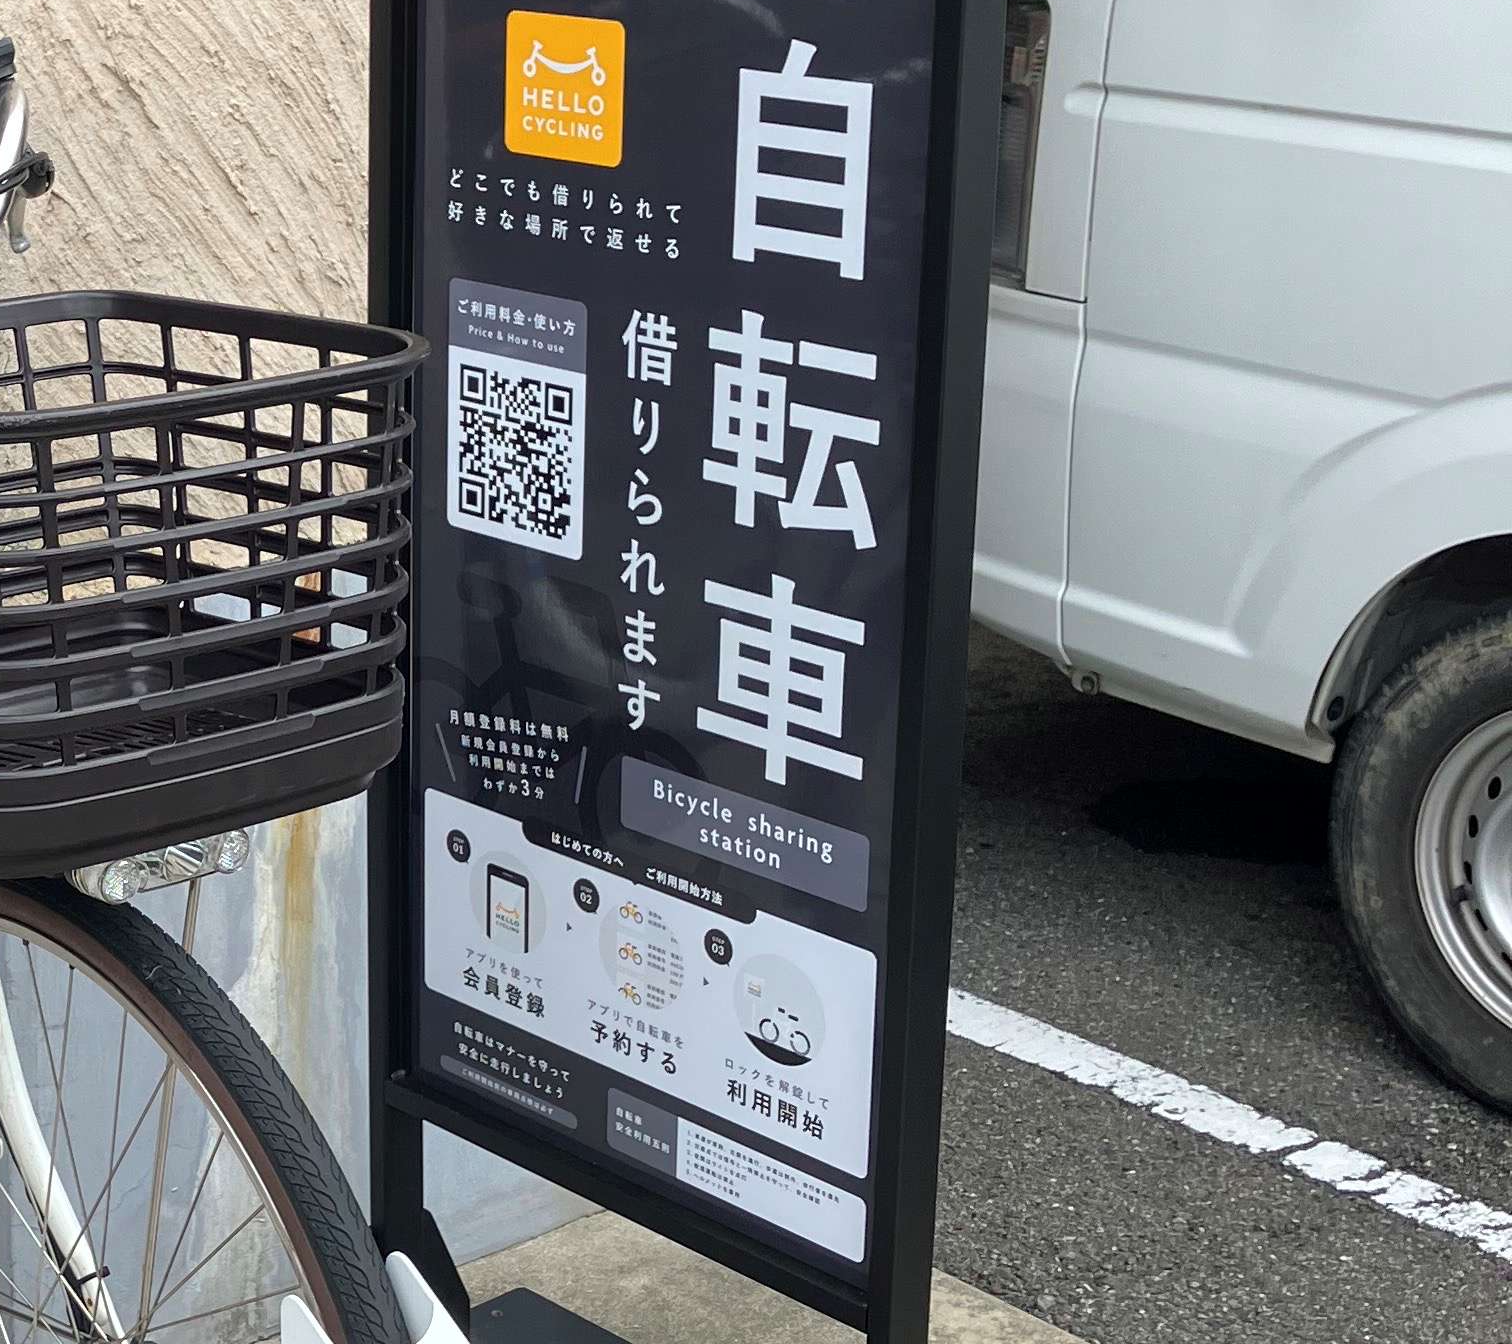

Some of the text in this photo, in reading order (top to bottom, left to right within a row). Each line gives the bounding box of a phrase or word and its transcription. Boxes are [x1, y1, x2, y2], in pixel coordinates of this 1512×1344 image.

[521, 87, 605, 117] HELLO
[521, 115, 605, 142] CYCLING
[447, 167, 683, 225] どこでも借りられて
[446, 199, 681, 260] 好きな場所で返せる
[457, 299, 577, 337] ご利用料金・使い方
[468, 324, 565, 354] Price & How to use
[696, 38, 881, 786] 自転車
[617, 308, 678, 731] 借りられます
[449, 709, 569, 743] 月額登録料は無料
[460, 734, 560, 763] 新規会員登録から
[468, 753, 555, 779] 利用開始までは
[483, 776, 545, 800] わずか3分
[652, 778, 835, 865] Bicycle sharing
[452, 843, 465, 855] 01
[550, 831, 624, 869] はじめての方へ
[698, 825, 783, 871] station
[579, 893, 593, 905] 02
[645, 866, 724, 907] ご利用開始方法
[463, 947, 543, 989] アプリを使って
[711, 943, 725, 956] 03
[462, 966, 546, 1018] 会員登録
[585, 998, 685, 1049] アプリで自転車を
[589, 1019, 677, 1075] 予約する
[724, 1057, 831, 1111] ロックを解錠して
[726, 1078, 826, 1141] 利用開始
